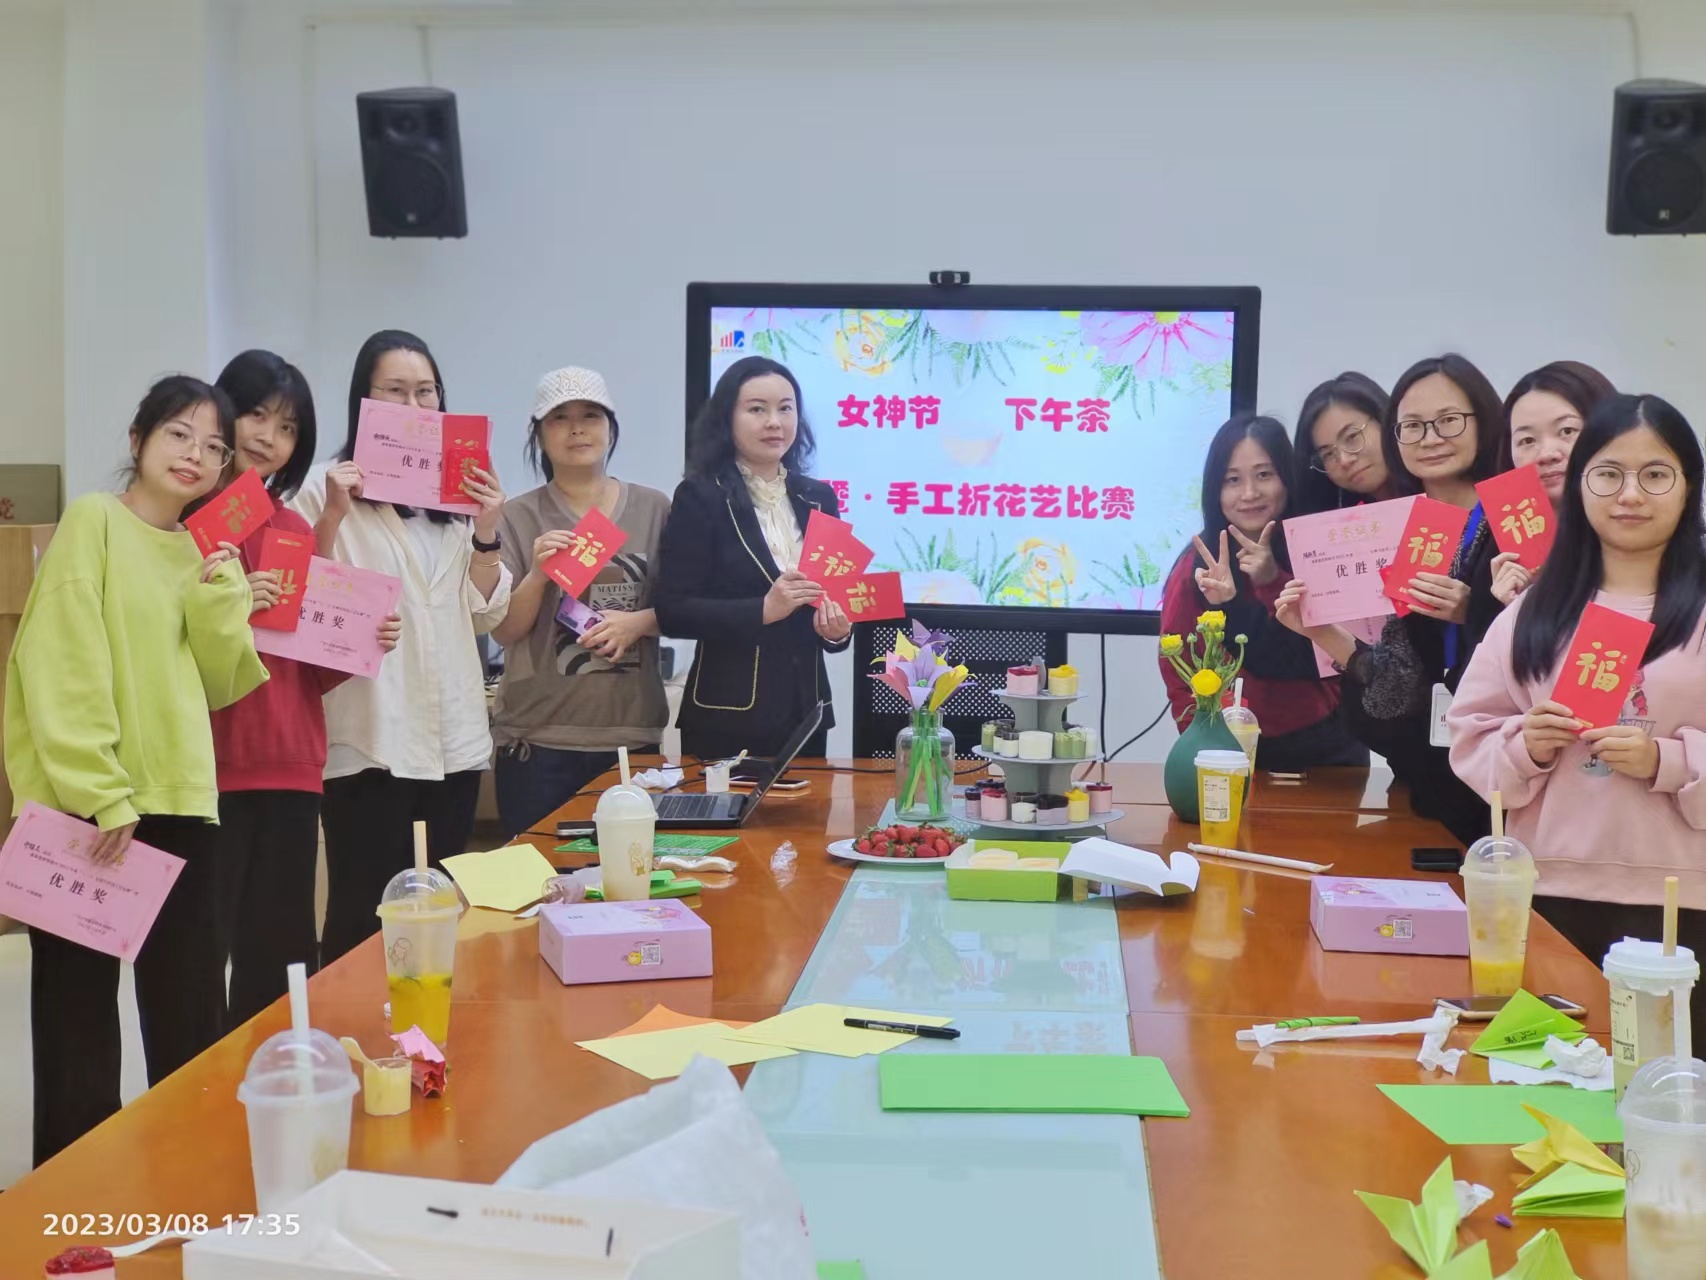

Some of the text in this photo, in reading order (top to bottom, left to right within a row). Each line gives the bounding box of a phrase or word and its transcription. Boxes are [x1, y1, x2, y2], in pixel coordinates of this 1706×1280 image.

[837, 394, 1111, 433] 女神节 下午茶
[1500, 498, 1546, 545] 福
[570, 532, 605, 568] 福
[1407, 526, 1445, 568] 福
[1576, 641, 1621, 693] 福
[49, 871, 108, 905] 优胜奖
